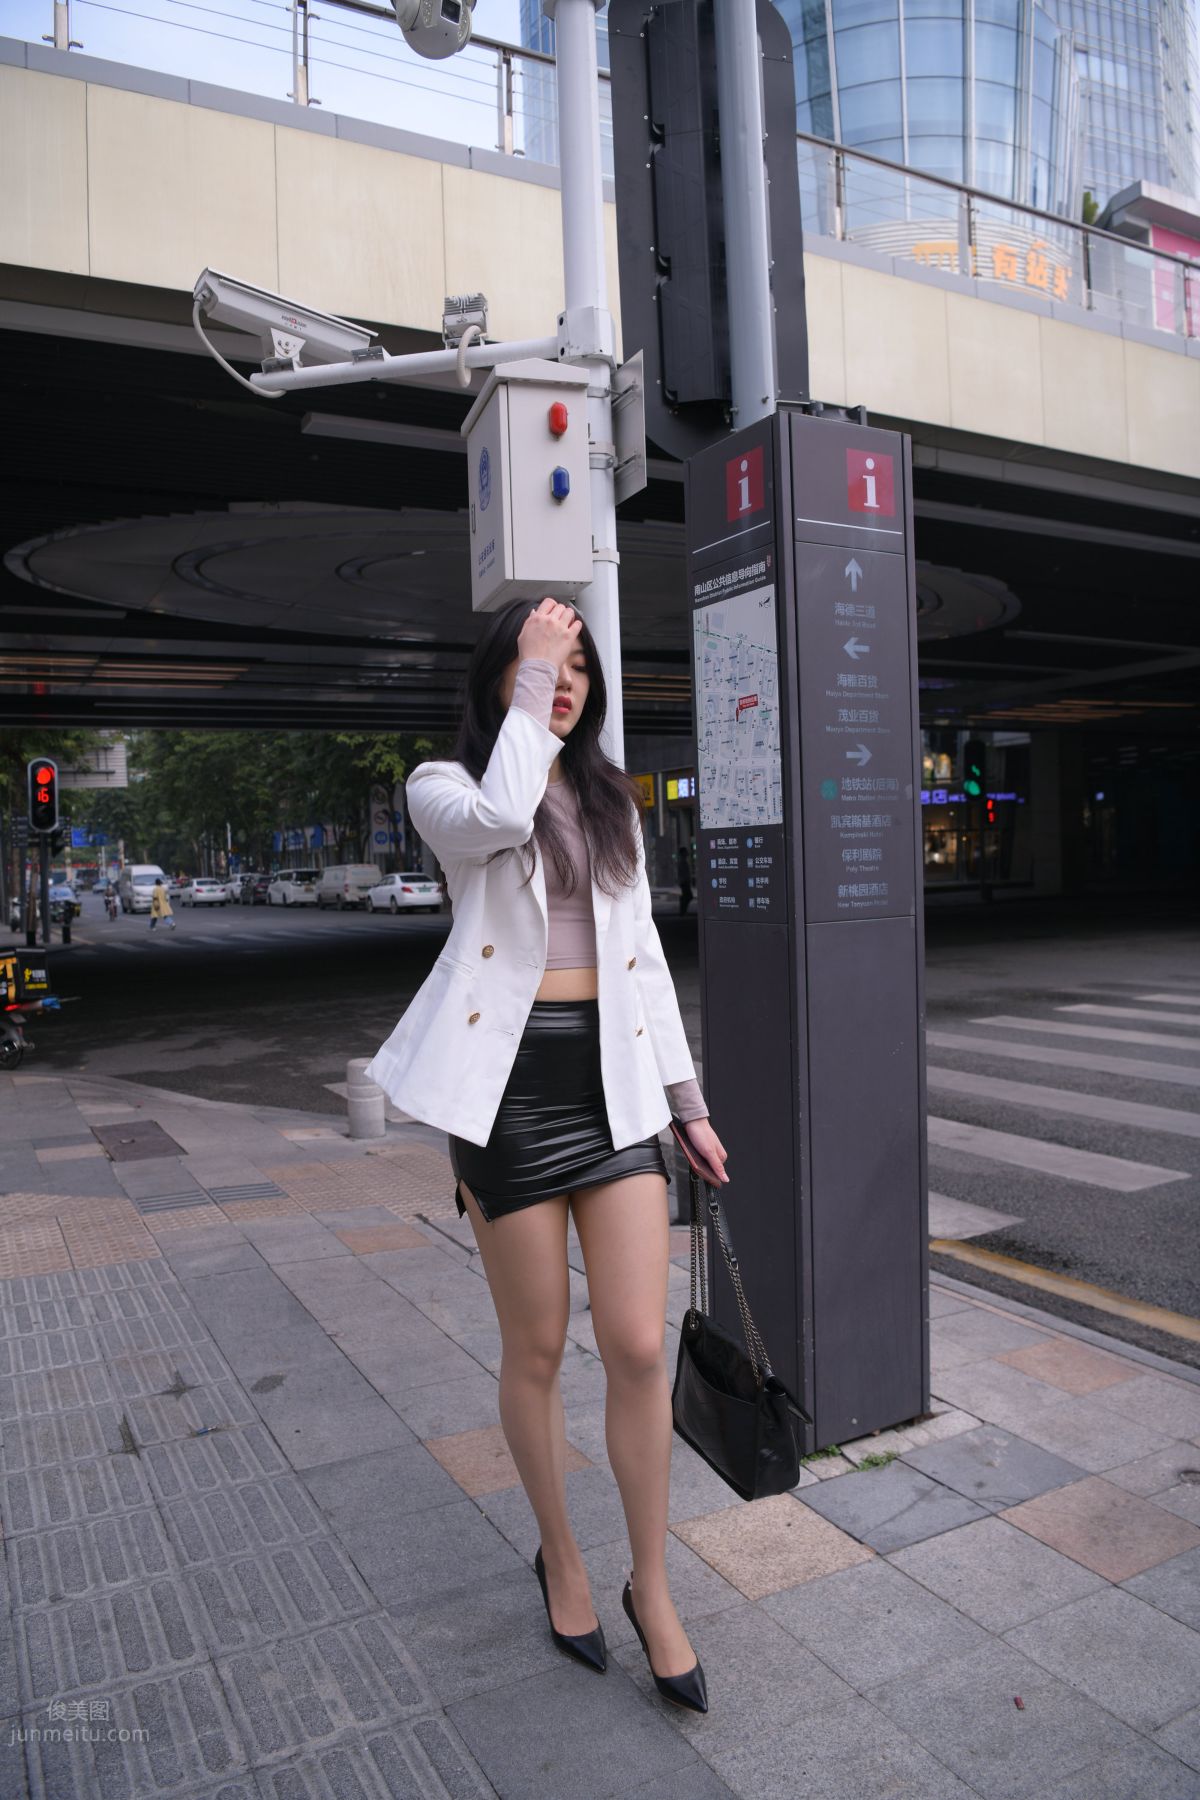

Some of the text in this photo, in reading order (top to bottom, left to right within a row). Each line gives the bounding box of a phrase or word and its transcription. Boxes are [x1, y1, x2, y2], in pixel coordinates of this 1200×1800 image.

[738, 459, 751, 512] i
[863, 457, 880, 508] i
[694, 561, 766, 597] 南山区公共信息导向指南
[835, 602, 876, 619] 海德三道
[837, 673, 878, 689] 海雅百货
[838, 709, 879, 723] 茂业百货
[37, 788, 49, 803] 16
[831, 814, 892, 828] 凯宾斯基酒店
[842, 848, 882, 862] 保利剧院
[838, 882, 888, 898] 新桃园酒店
